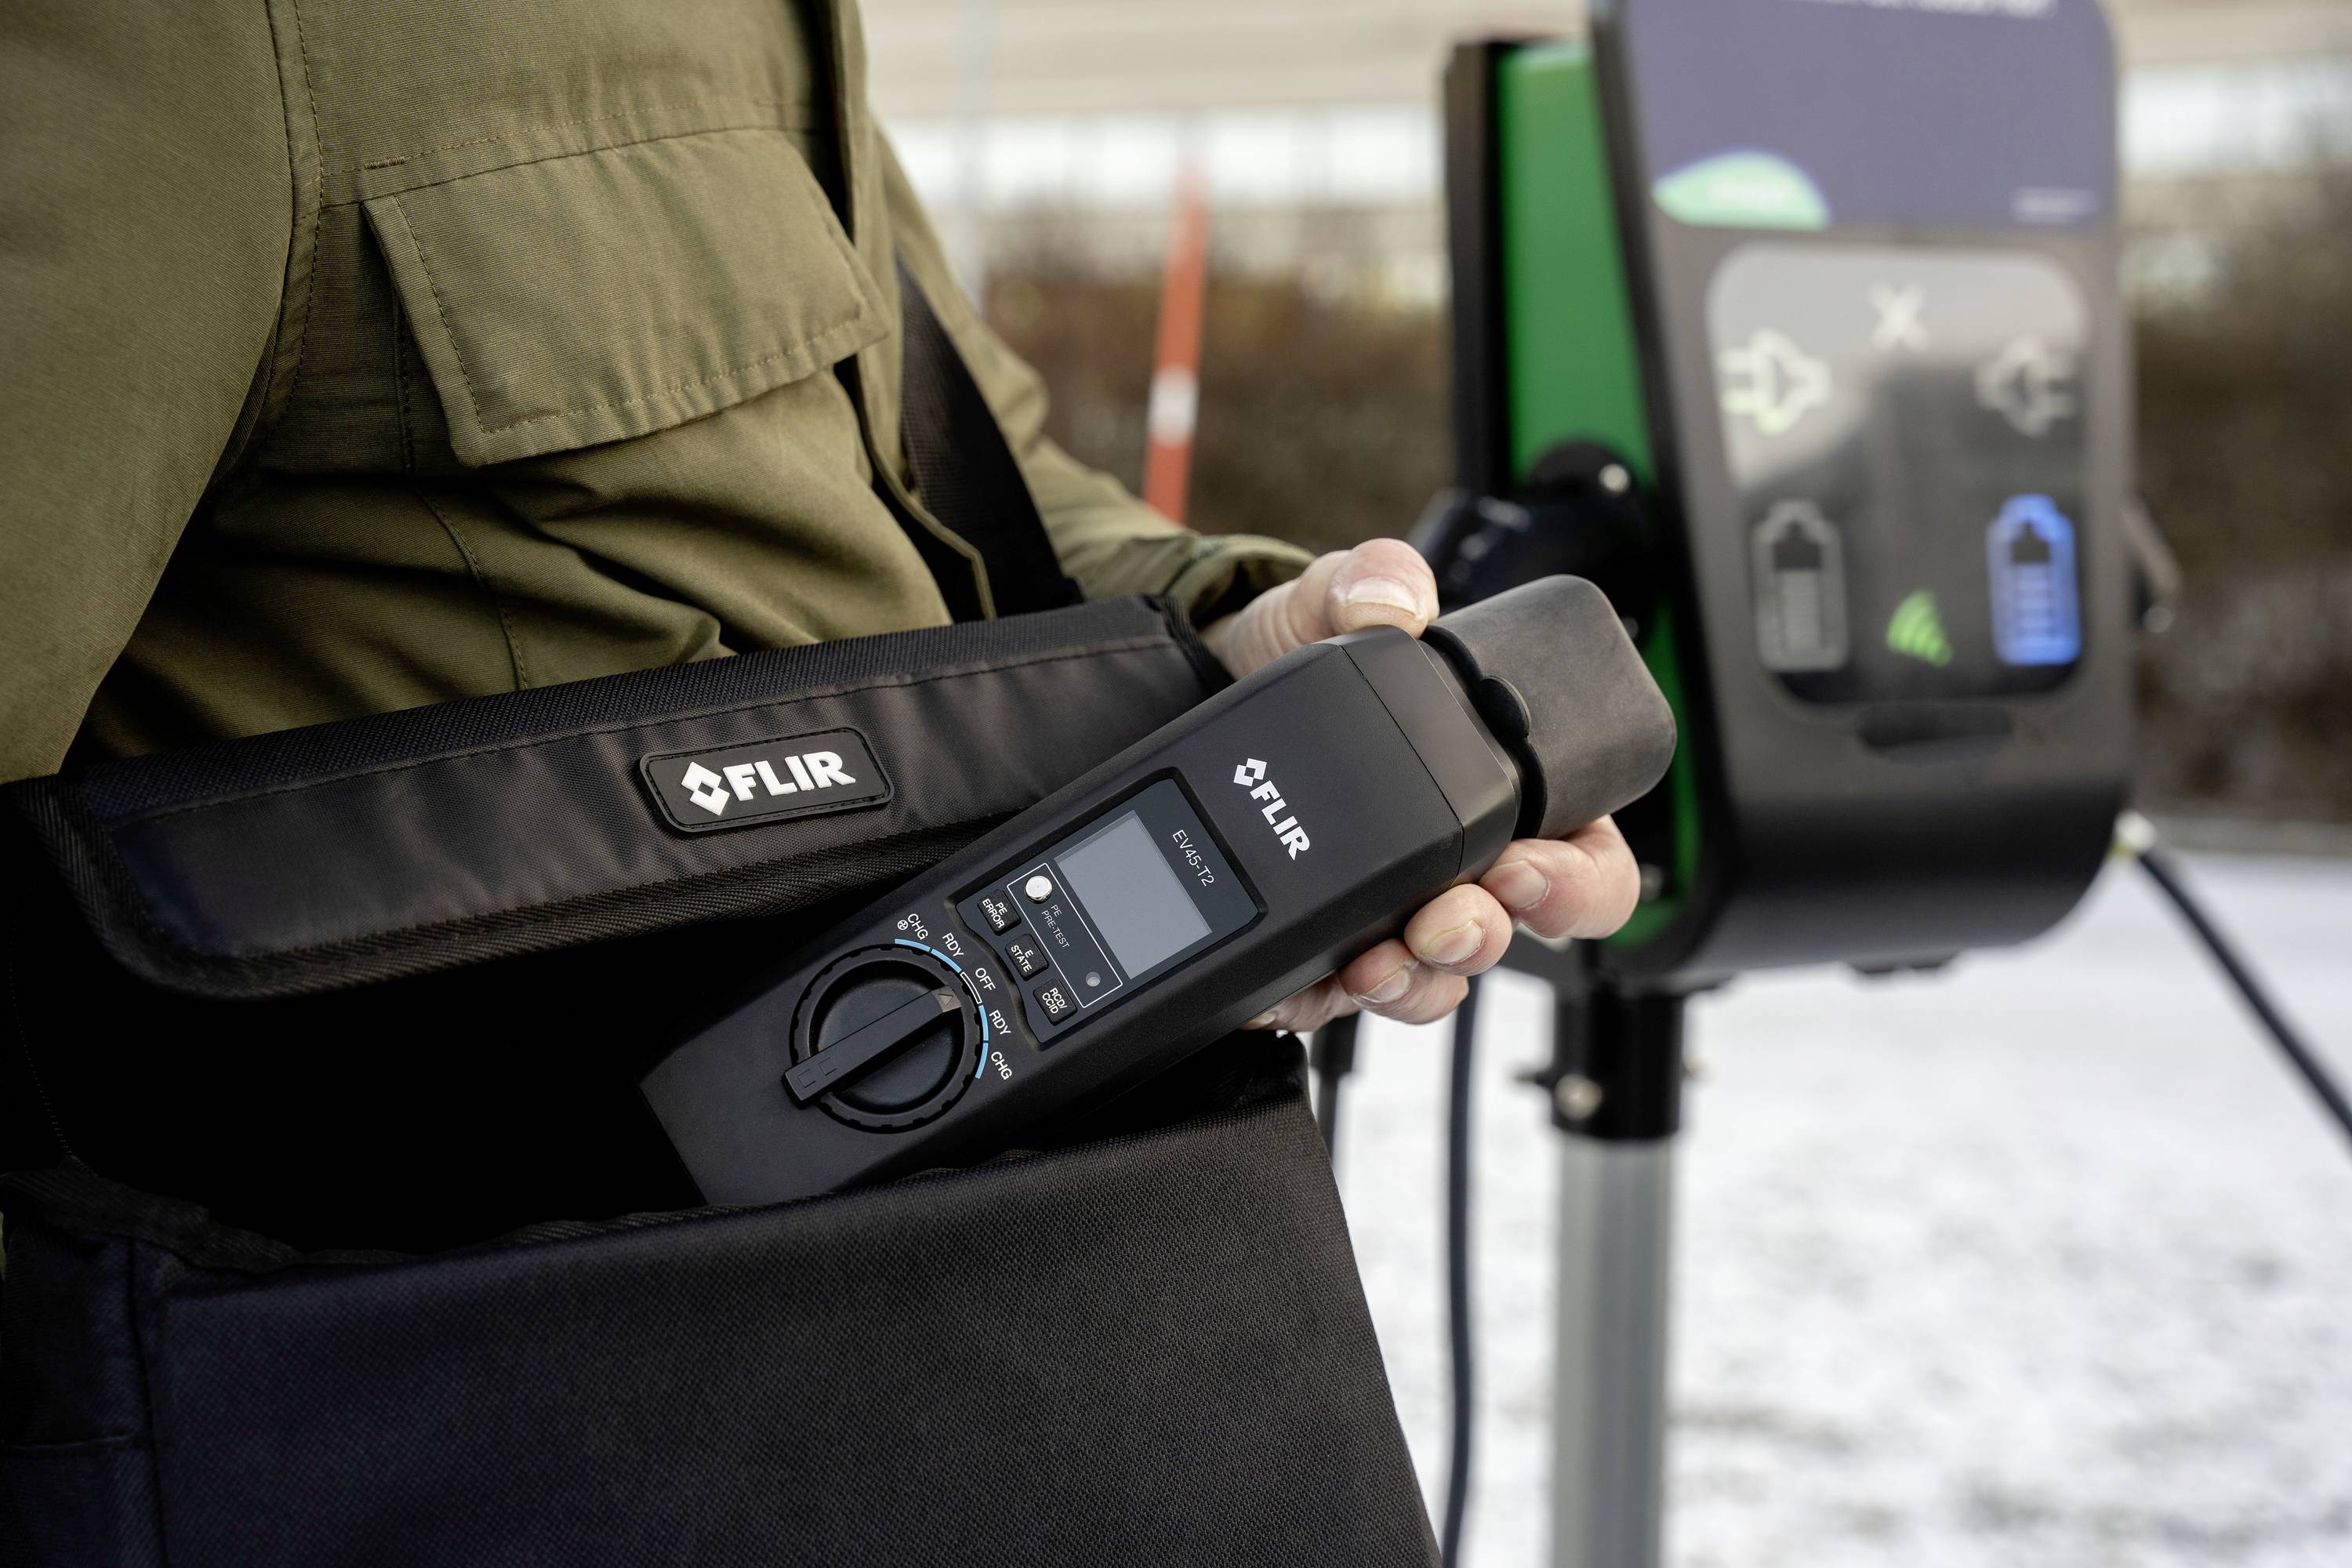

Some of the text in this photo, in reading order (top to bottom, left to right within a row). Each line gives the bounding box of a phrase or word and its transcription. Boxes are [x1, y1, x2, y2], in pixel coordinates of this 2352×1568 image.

[722, 751, 856, 801] FLIR
[1250, 780, 1310, 861] FLIR
[1172, 829, 1214, 887] EV45-T2
[982, 898, 1005, 928] ERROR
[996, 902, 1007, 916] PE
[1051, 904, 1062, 917] PE
[907, 913, 929, 940] CHG
[1041, 909, 1070, 948] PRE-TEST
[942, 932, 964, 957] RDY
[1024, 949, 1034, 958] E
[1011, 945, 1033, 973] STATE
[975, 967, 996, 991] OFF
[1042, 992, 1059, 1014] CCID
[1049, 987, 1068, 1009] RCD/
[989, 1009, 1011, 1035] RDY
[990, 1051, 1013, 1080] CHG
